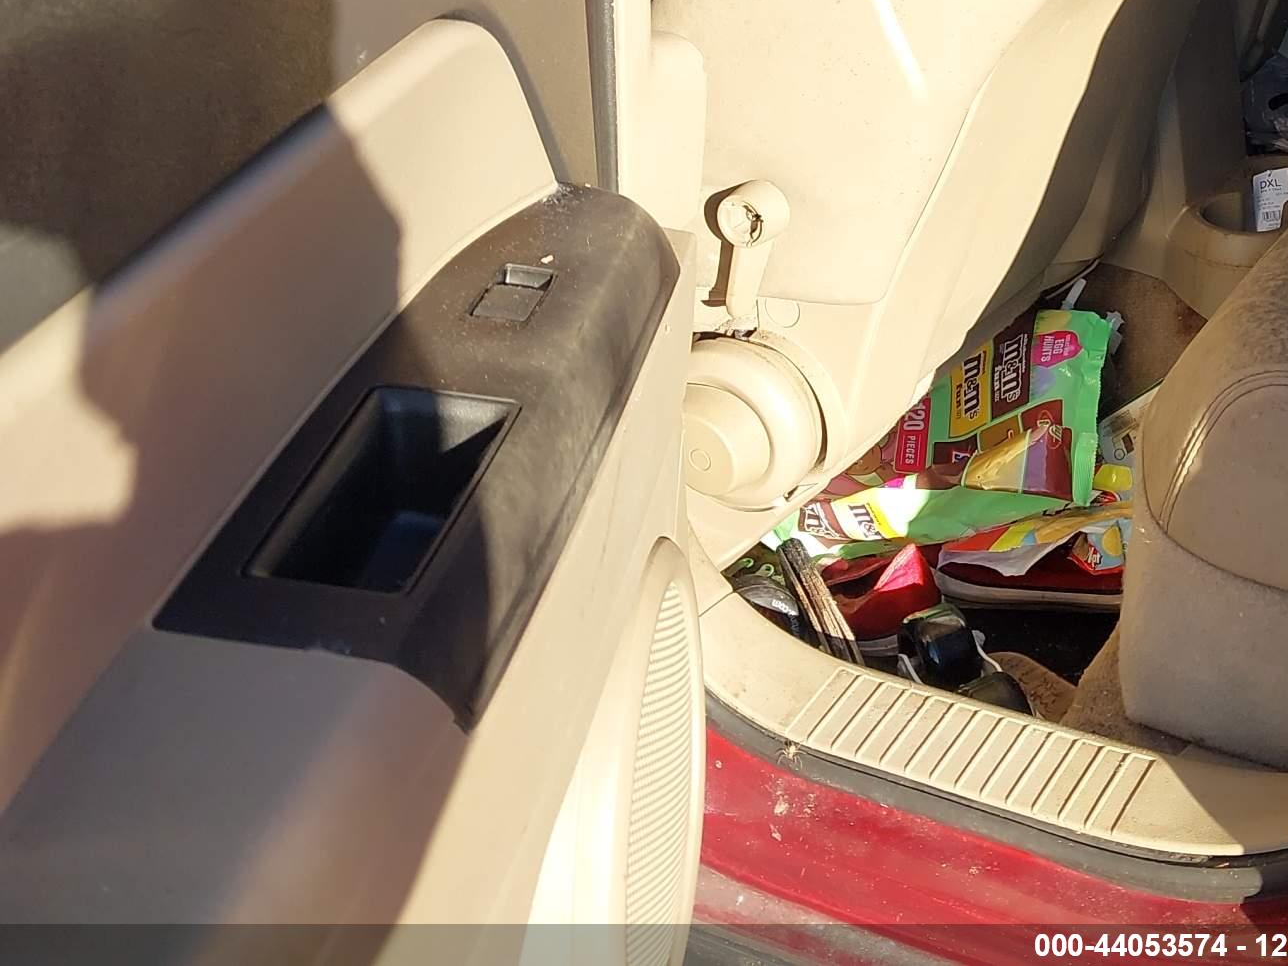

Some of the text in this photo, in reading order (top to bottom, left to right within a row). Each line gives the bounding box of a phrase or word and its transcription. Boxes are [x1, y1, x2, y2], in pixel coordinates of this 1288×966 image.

[1260, 178, 1282, 189] DXL
[1040, 335, 1055, 362] HUNTS
[1053, 338, 1065, 354] EGG
[994, 365, 1003, 391] fun
[904, 435, 916, 464] PIECES
